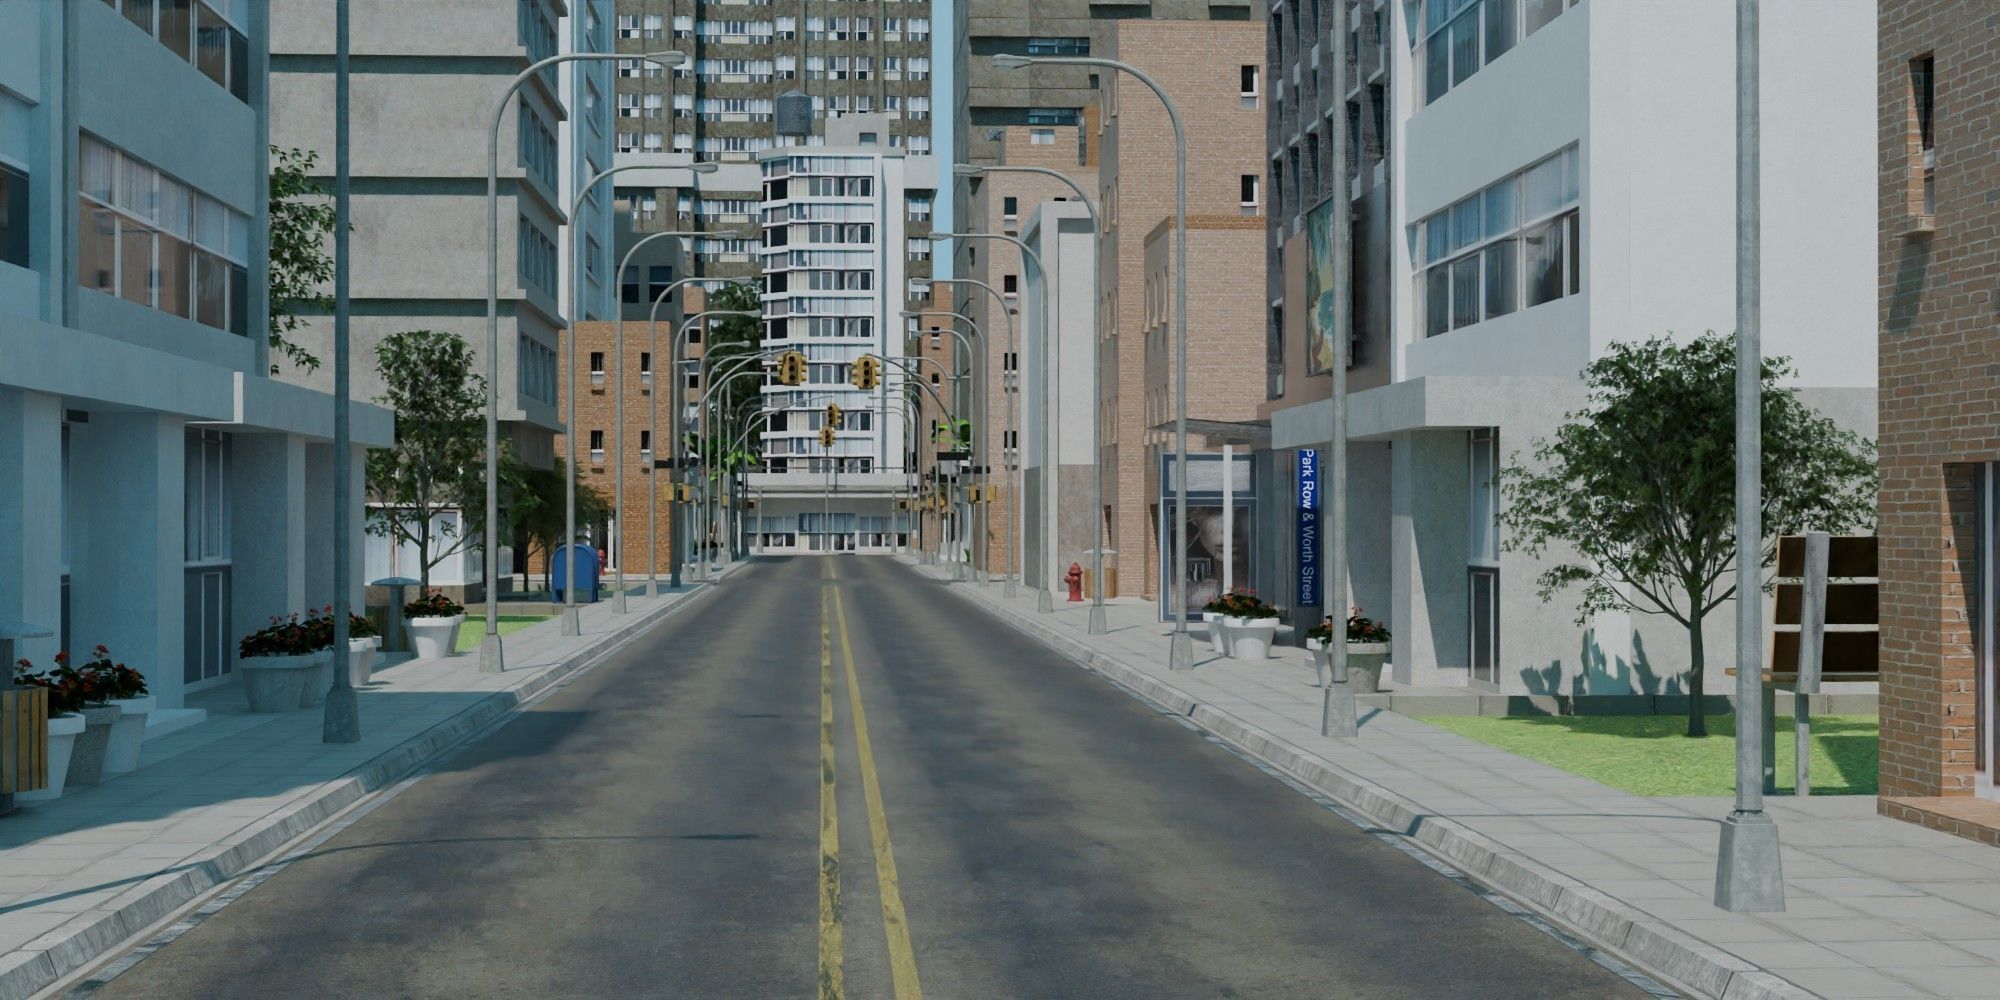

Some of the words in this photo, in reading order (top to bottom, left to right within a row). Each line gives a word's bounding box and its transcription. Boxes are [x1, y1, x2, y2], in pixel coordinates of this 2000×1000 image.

[1302, 448, 1315, 478] Park
[1302, 480, 1315, 509] Row
[1302, 512, 1315, 522] &
[1302, 525, 1315, 562] Worth
[1302, 566, 1315, 604] Street
